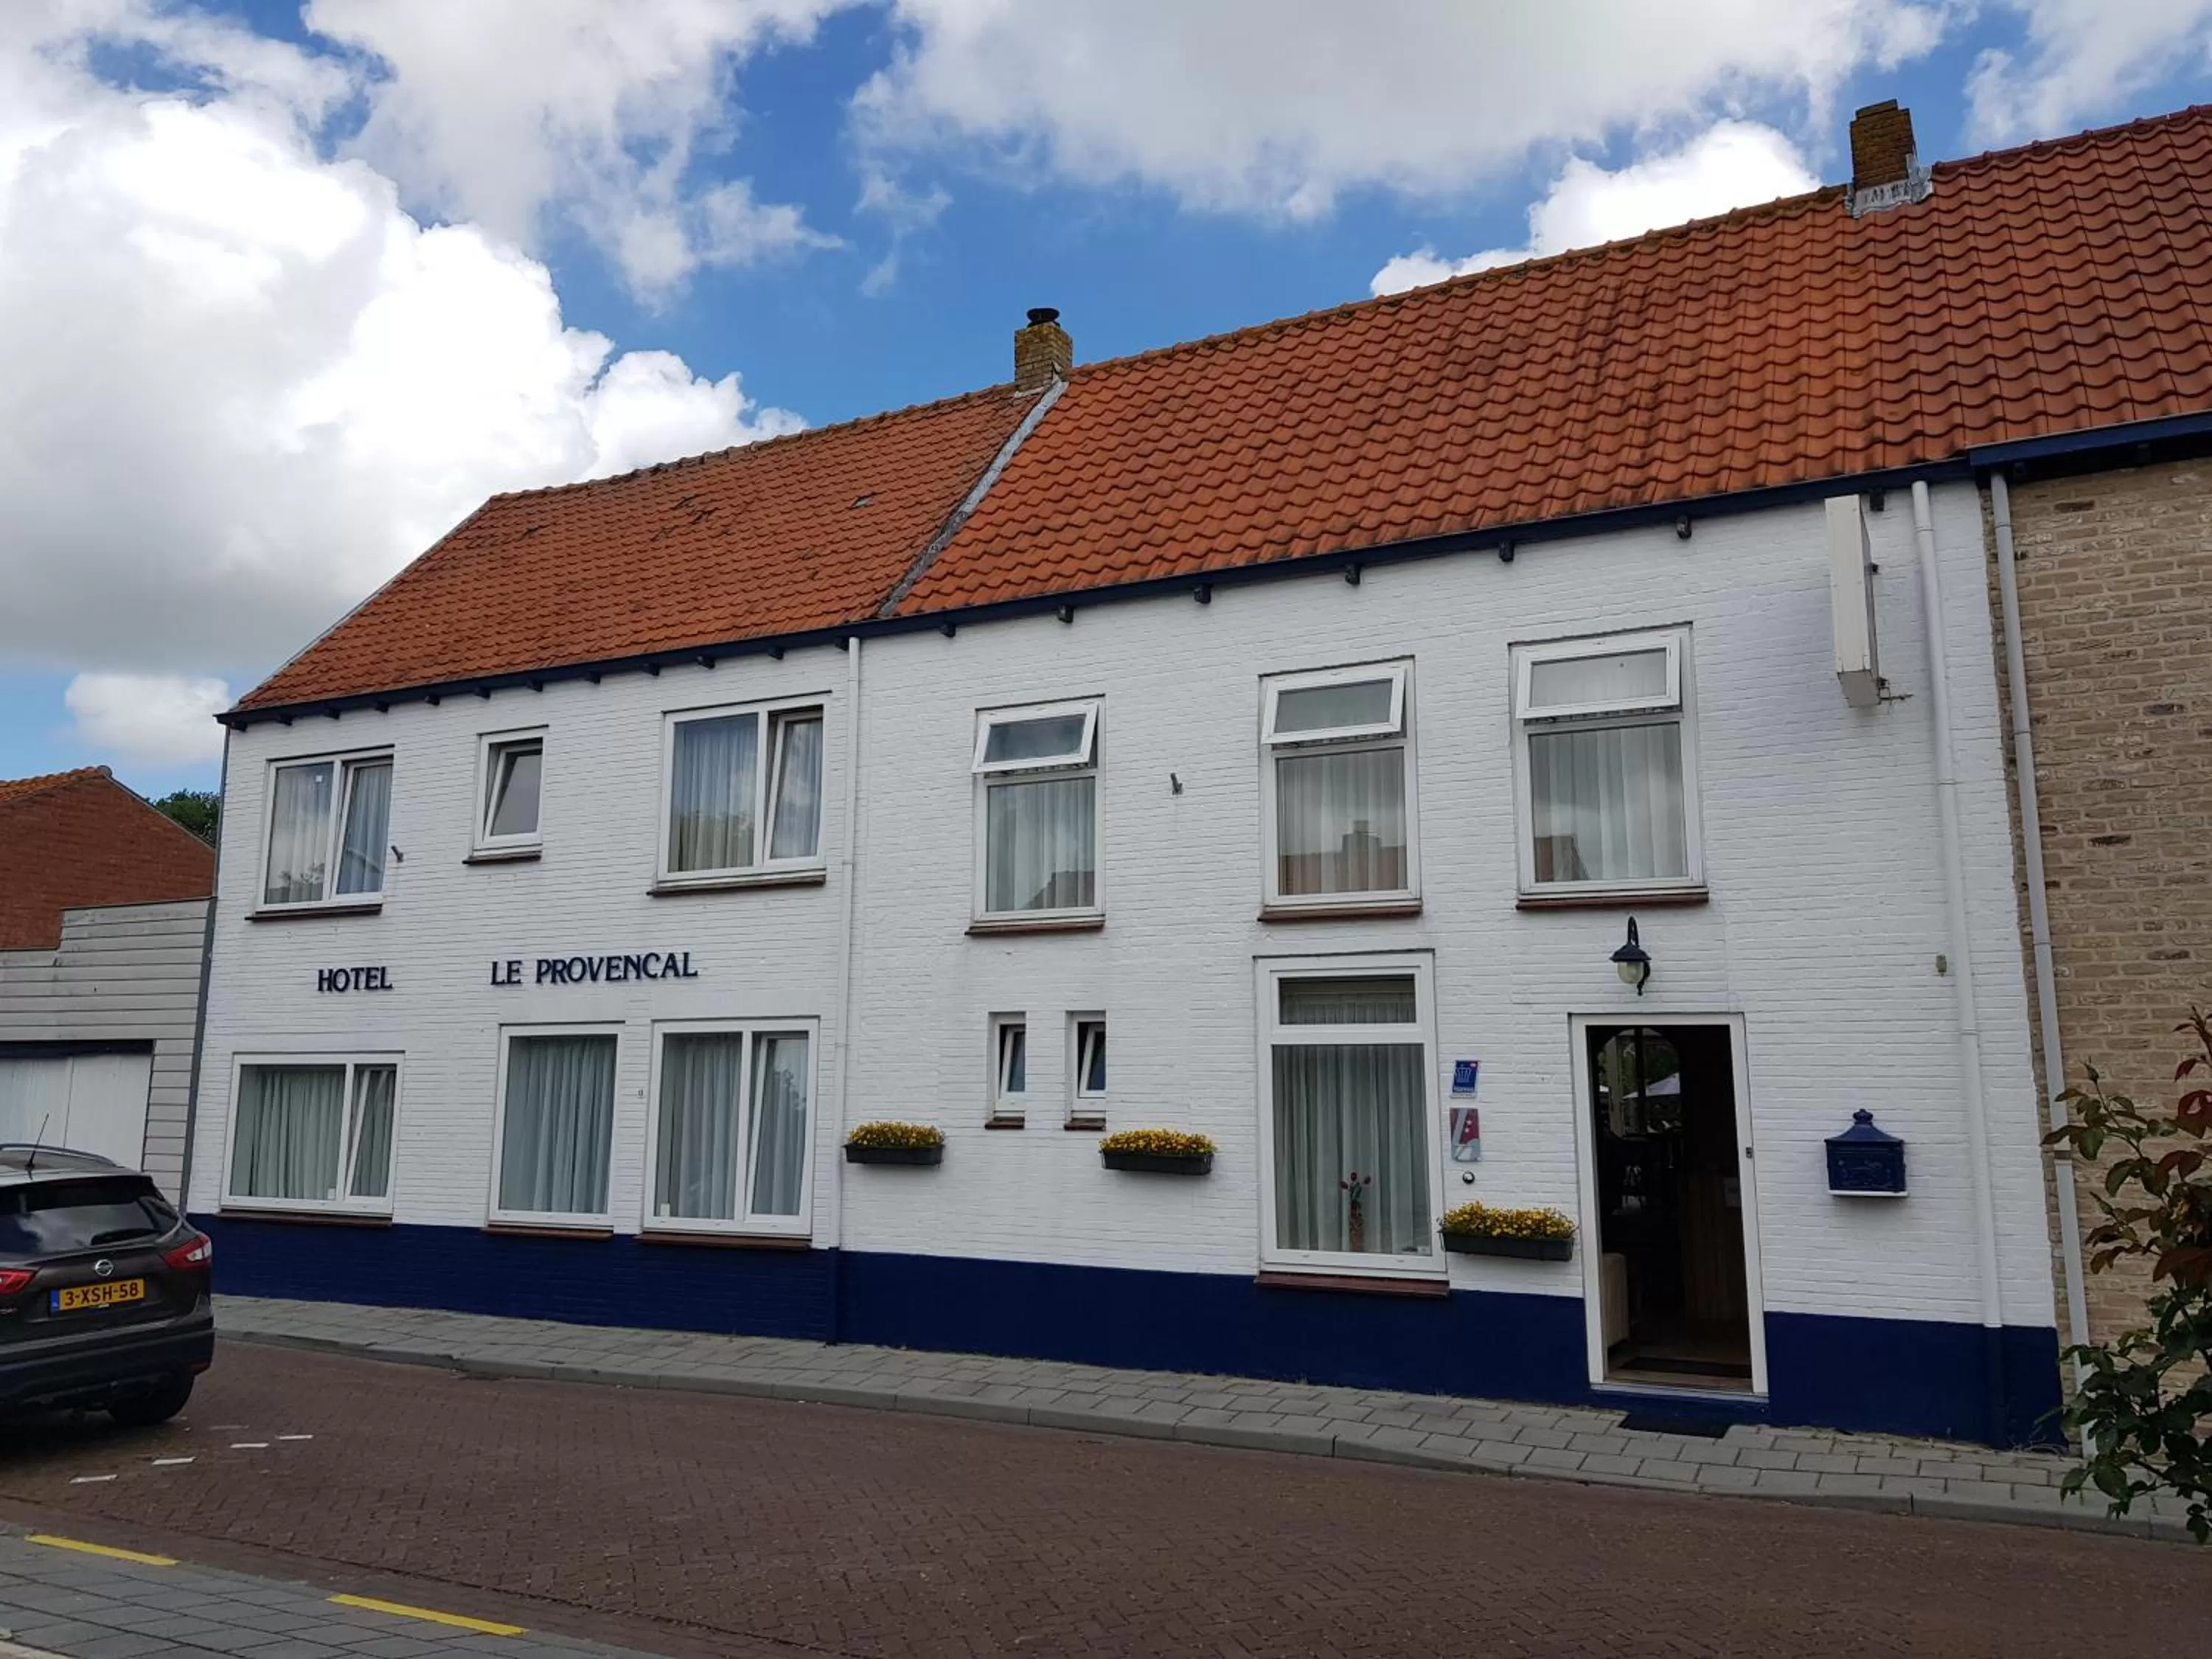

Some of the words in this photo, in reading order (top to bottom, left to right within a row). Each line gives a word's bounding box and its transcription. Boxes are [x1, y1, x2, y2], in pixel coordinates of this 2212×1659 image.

[318, 967, 393, 992] HOTEL
[490, 960, 522, 985] LE
[535, 952, 698, 984] PROVENCAL
[65, 1281, 139, 1307] 3-XSH-58
